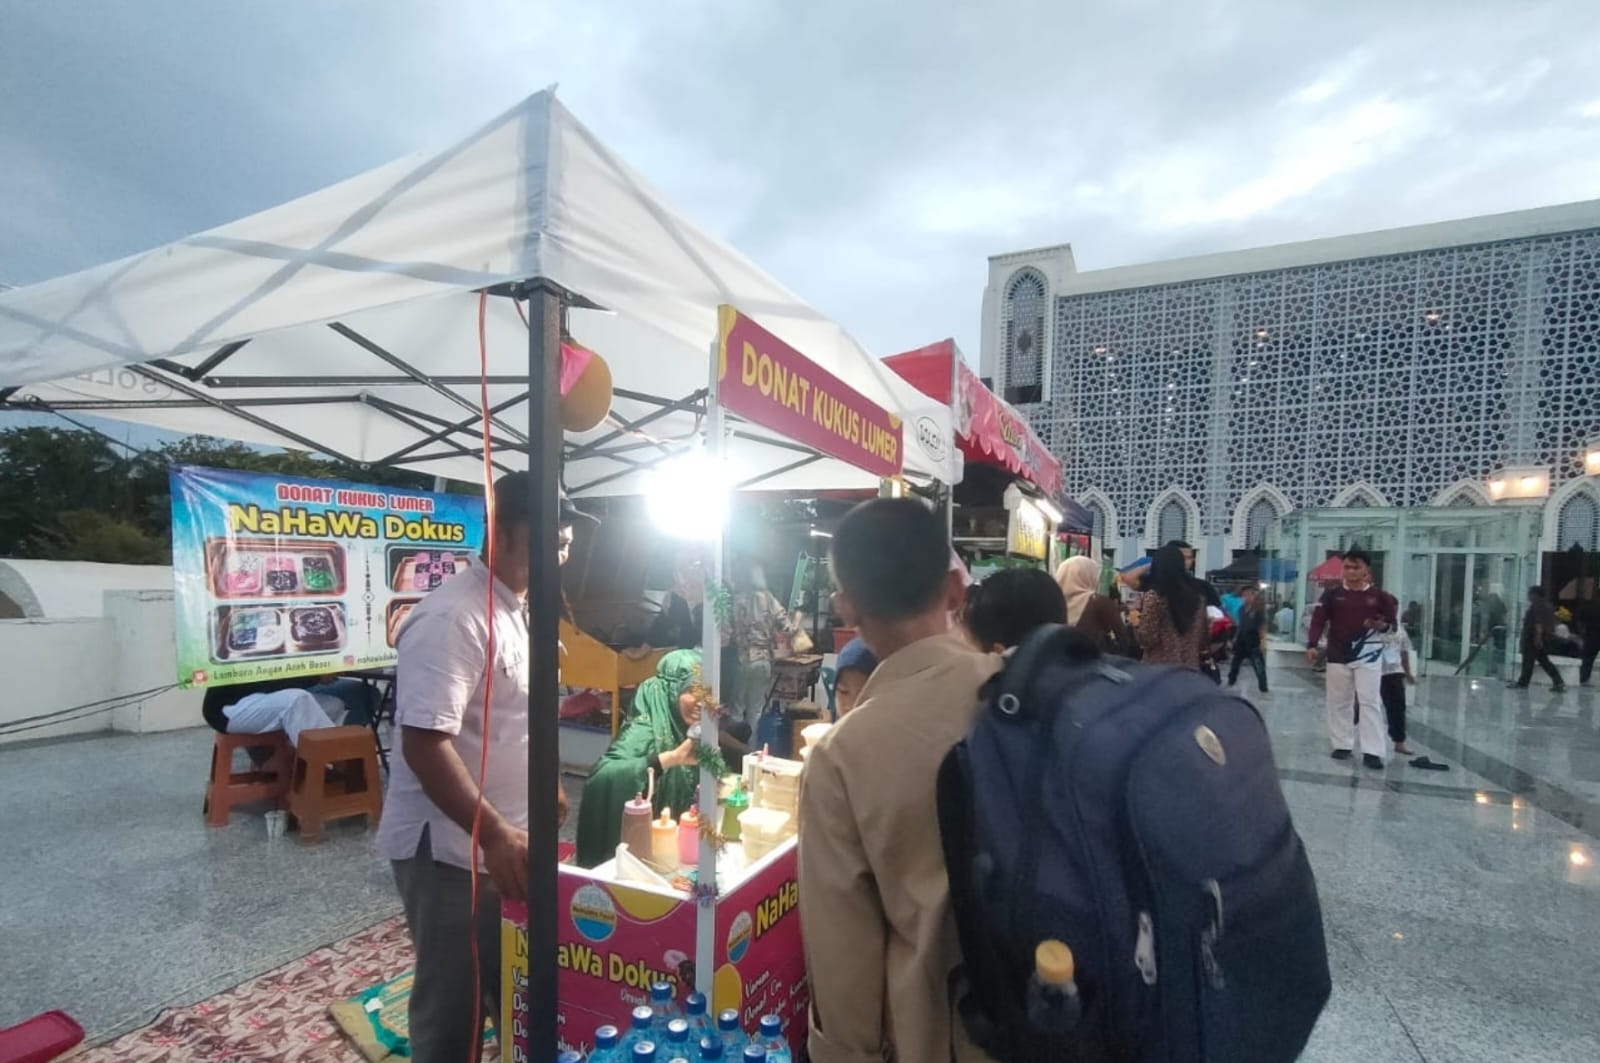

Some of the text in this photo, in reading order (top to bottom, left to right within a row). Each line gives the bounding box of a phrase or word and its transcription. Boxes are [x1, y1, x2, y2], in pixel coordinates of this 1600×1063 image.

[741, 341, 810, 416] DONAT
[813, 387, 860, 445] KUKUS
[862, 417, 898, 466] LUMER
[276, 484, 434, 512] DONAT KUKUS LUMER
[229, 504, 464, 542] NaHaWa Dokus
[755, 880, 798, 940] NaHa
